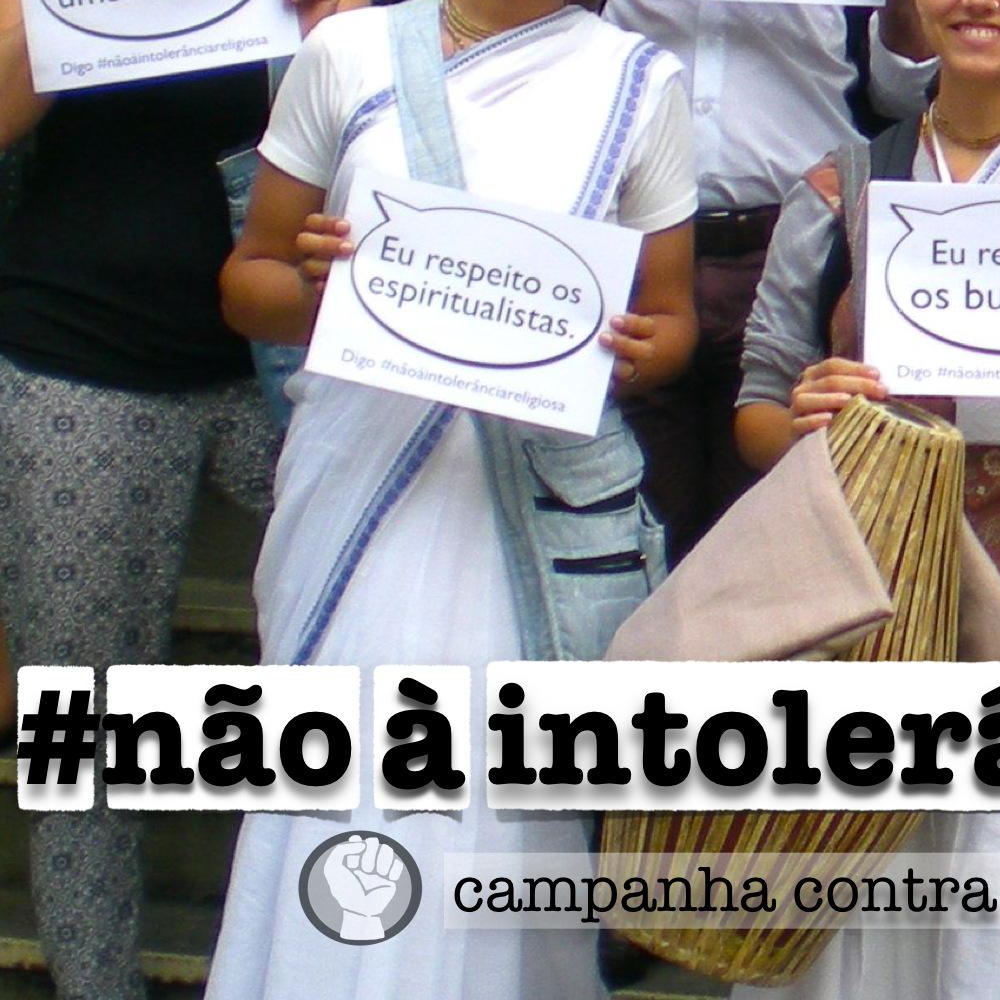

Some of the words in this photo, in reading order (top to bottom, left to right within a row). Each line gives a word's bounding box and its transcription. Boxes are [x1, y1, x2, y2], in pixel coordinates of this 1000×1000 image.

[60, 60, 94, 77] Digo
[932, 239, 966, 266] Eu
[380, 235, 415, 267] Eu
[425, 251, 541, 295] respeito
[552, 283, 581, 305] os
[368, 274, 576, 340] espiritualistas.
[911, 287, 949, 310] os
[341, 347, 376, 371] Digo
[896, 364, 932, 384] Digo
